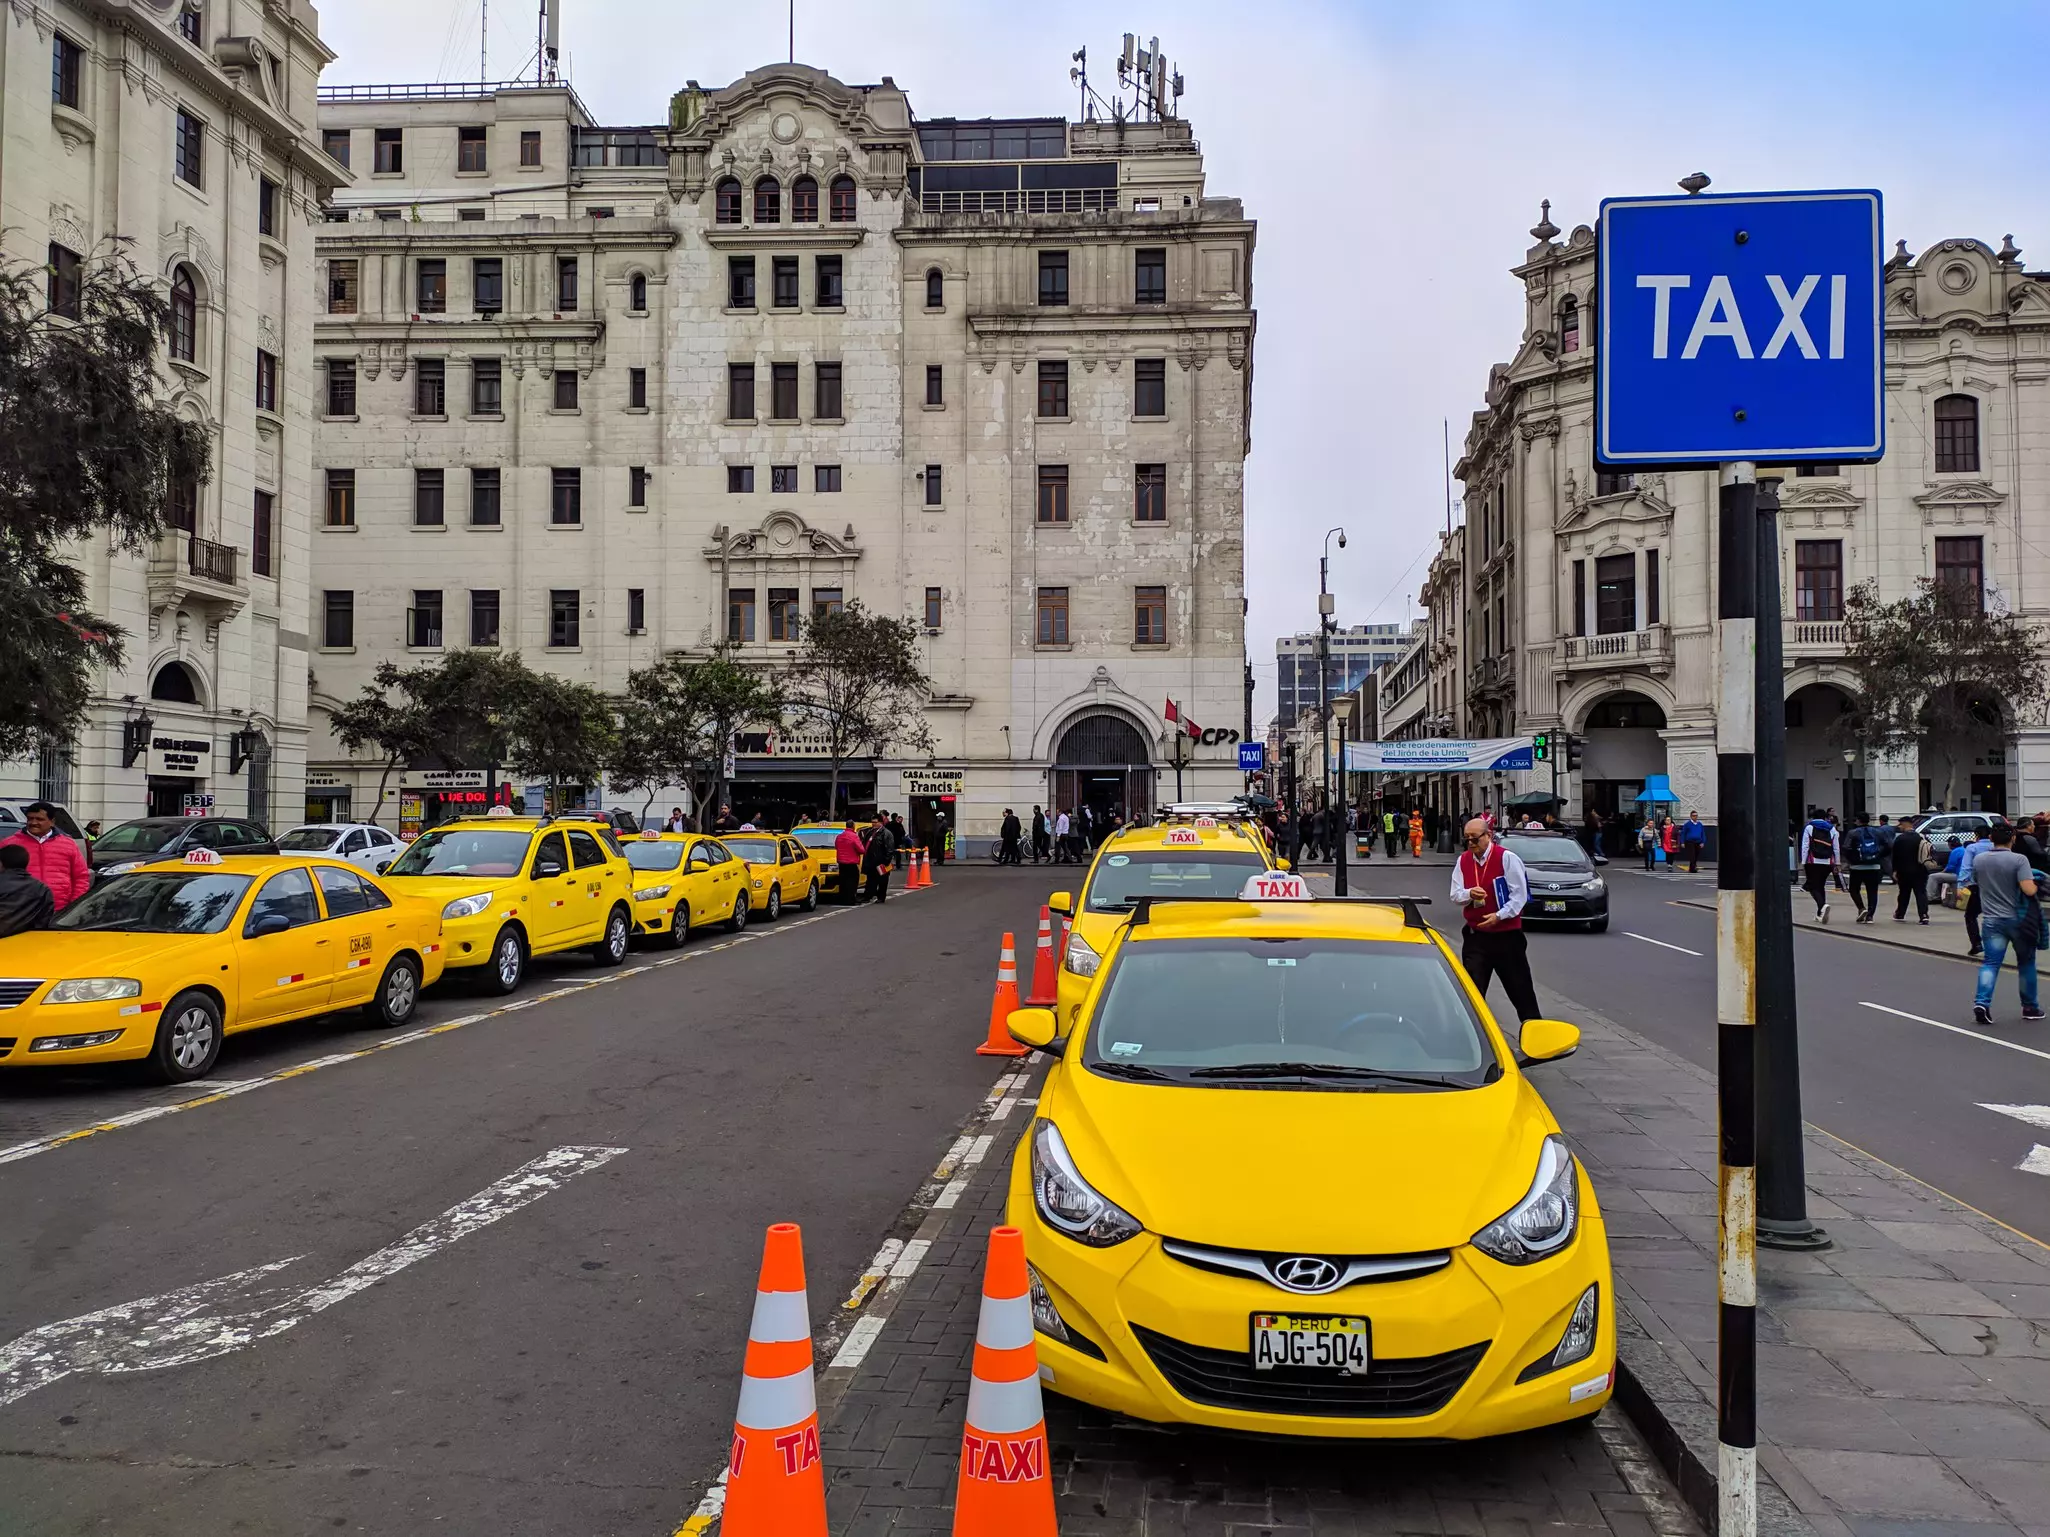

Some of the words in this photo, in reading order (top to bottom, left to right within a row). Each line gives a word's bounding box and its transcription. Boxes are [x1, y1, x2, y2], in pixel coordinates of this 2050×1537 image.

[1636, 274, 1846, 359] TAXI
[1241, 751, 1259, 761] TAXI
[1397, 749, 1417, 757] Jirón
[1441, 749, 1467, 757] Unión
[903, 771, 925, 779] CASA
[931, 771, 962, 779] CAMBIO
[910, 780, 952, 793] Francis
[1170, 833, 1195, 842] TAXI
[189, 852, 212, 863] TAXI
[1256, 881, 1299, 898] TAXI
[1290, 1319, 1330, 1331] PERU
[1258, 1330, 1364, 1367] AJG-504
[964, 1433, 1044, 1483] TAXI
